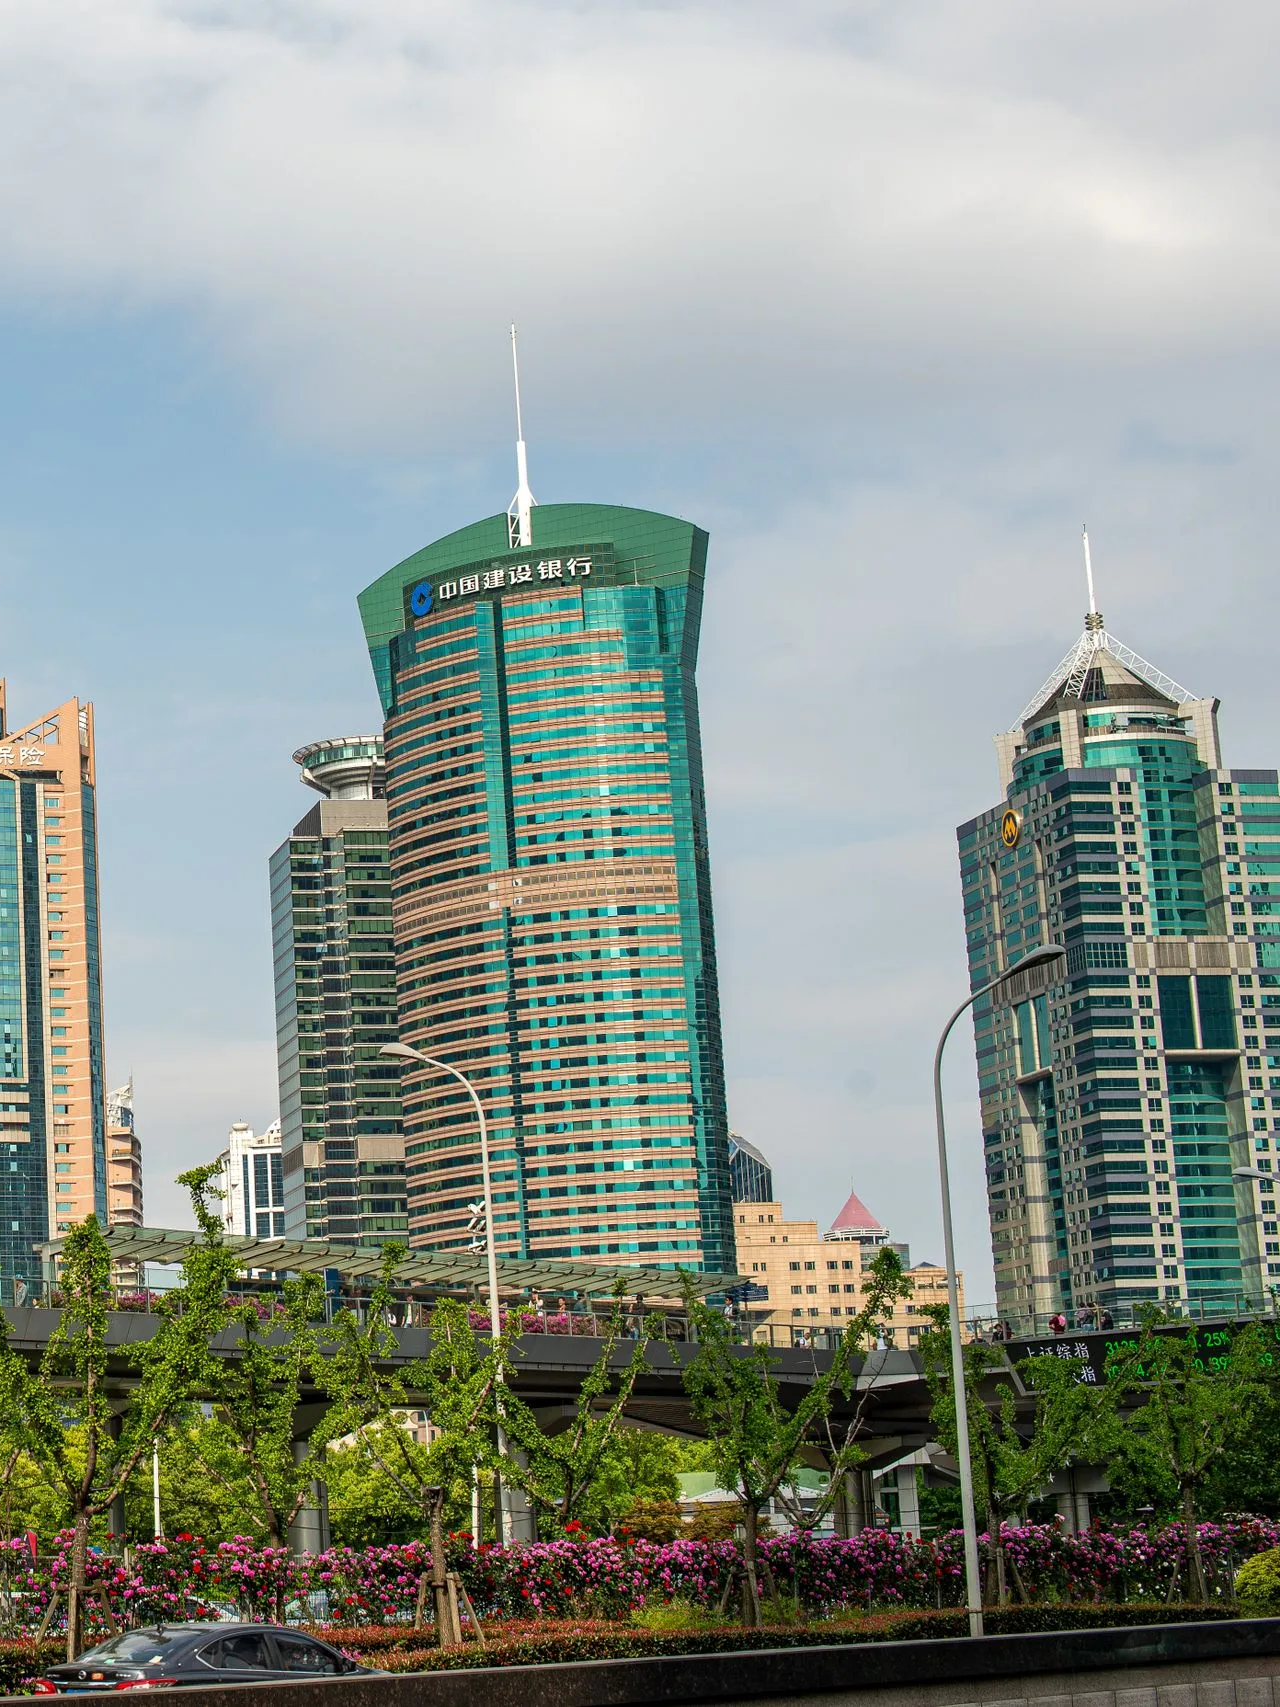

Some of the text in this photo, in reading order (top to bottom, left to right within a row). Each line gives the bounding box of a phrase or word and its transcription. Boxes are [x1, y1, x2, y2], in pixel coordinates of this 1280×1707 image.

[439, 557, 592, 600] 中国建设银行
